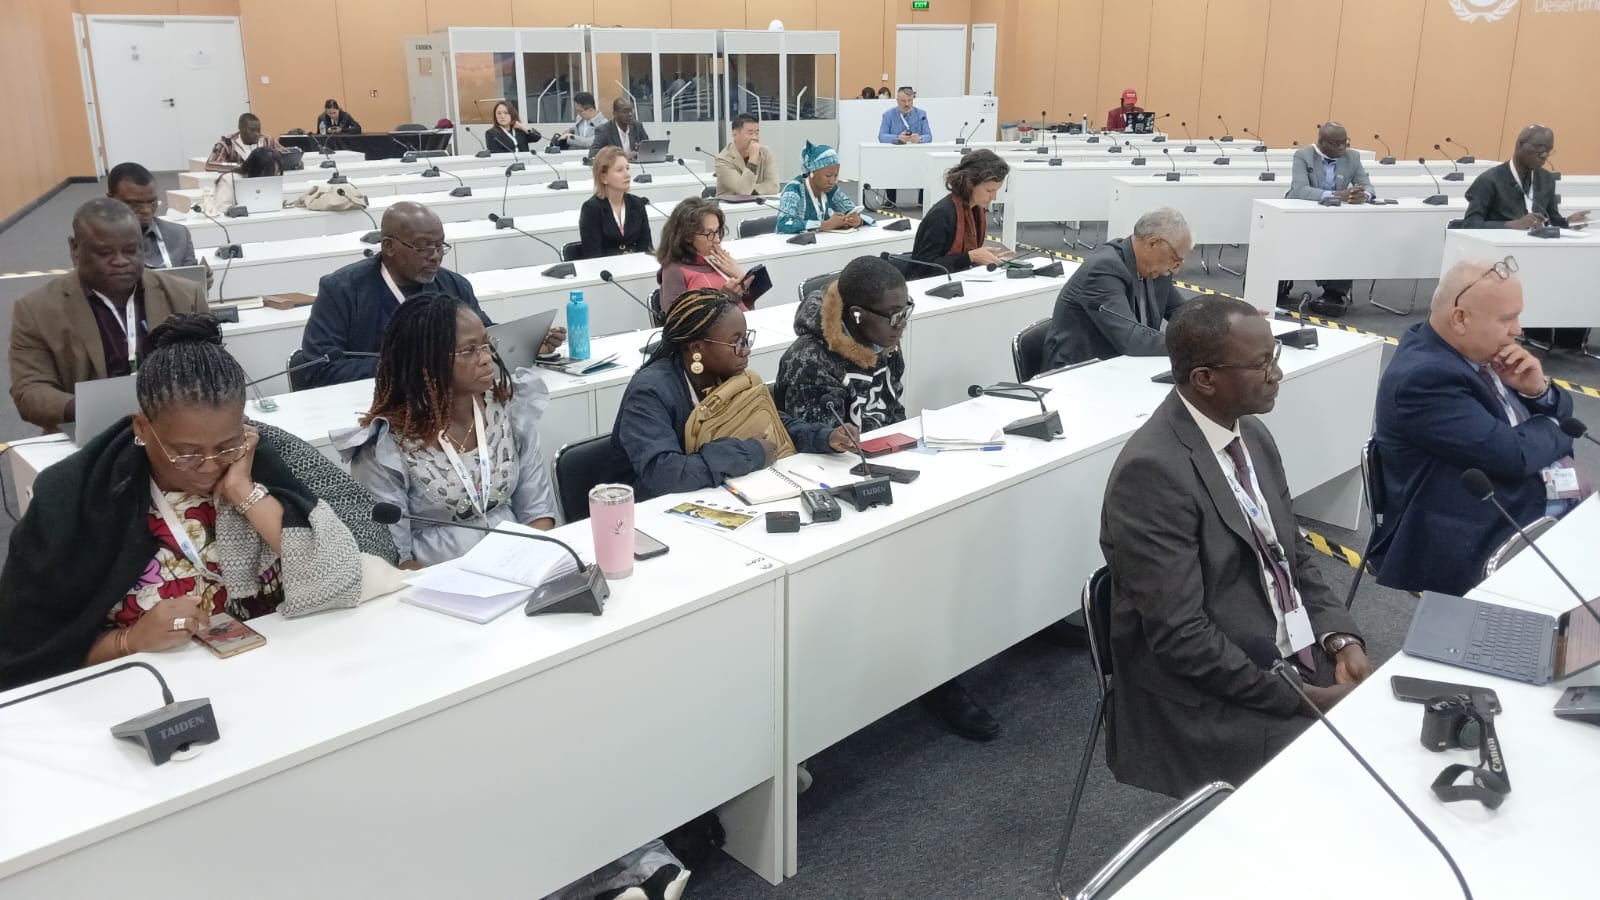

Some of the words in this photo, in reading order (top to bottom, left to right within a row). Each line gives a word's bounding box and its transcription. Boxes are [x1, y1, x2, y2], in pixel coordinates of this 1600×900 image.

[1535, 0, 1600, 12] Desertifi
[862, 486, 887, 497] TAIDEN
[158, 714, 205, 740] TAIDEN
[1487, 737, 1503, 773] Canon
